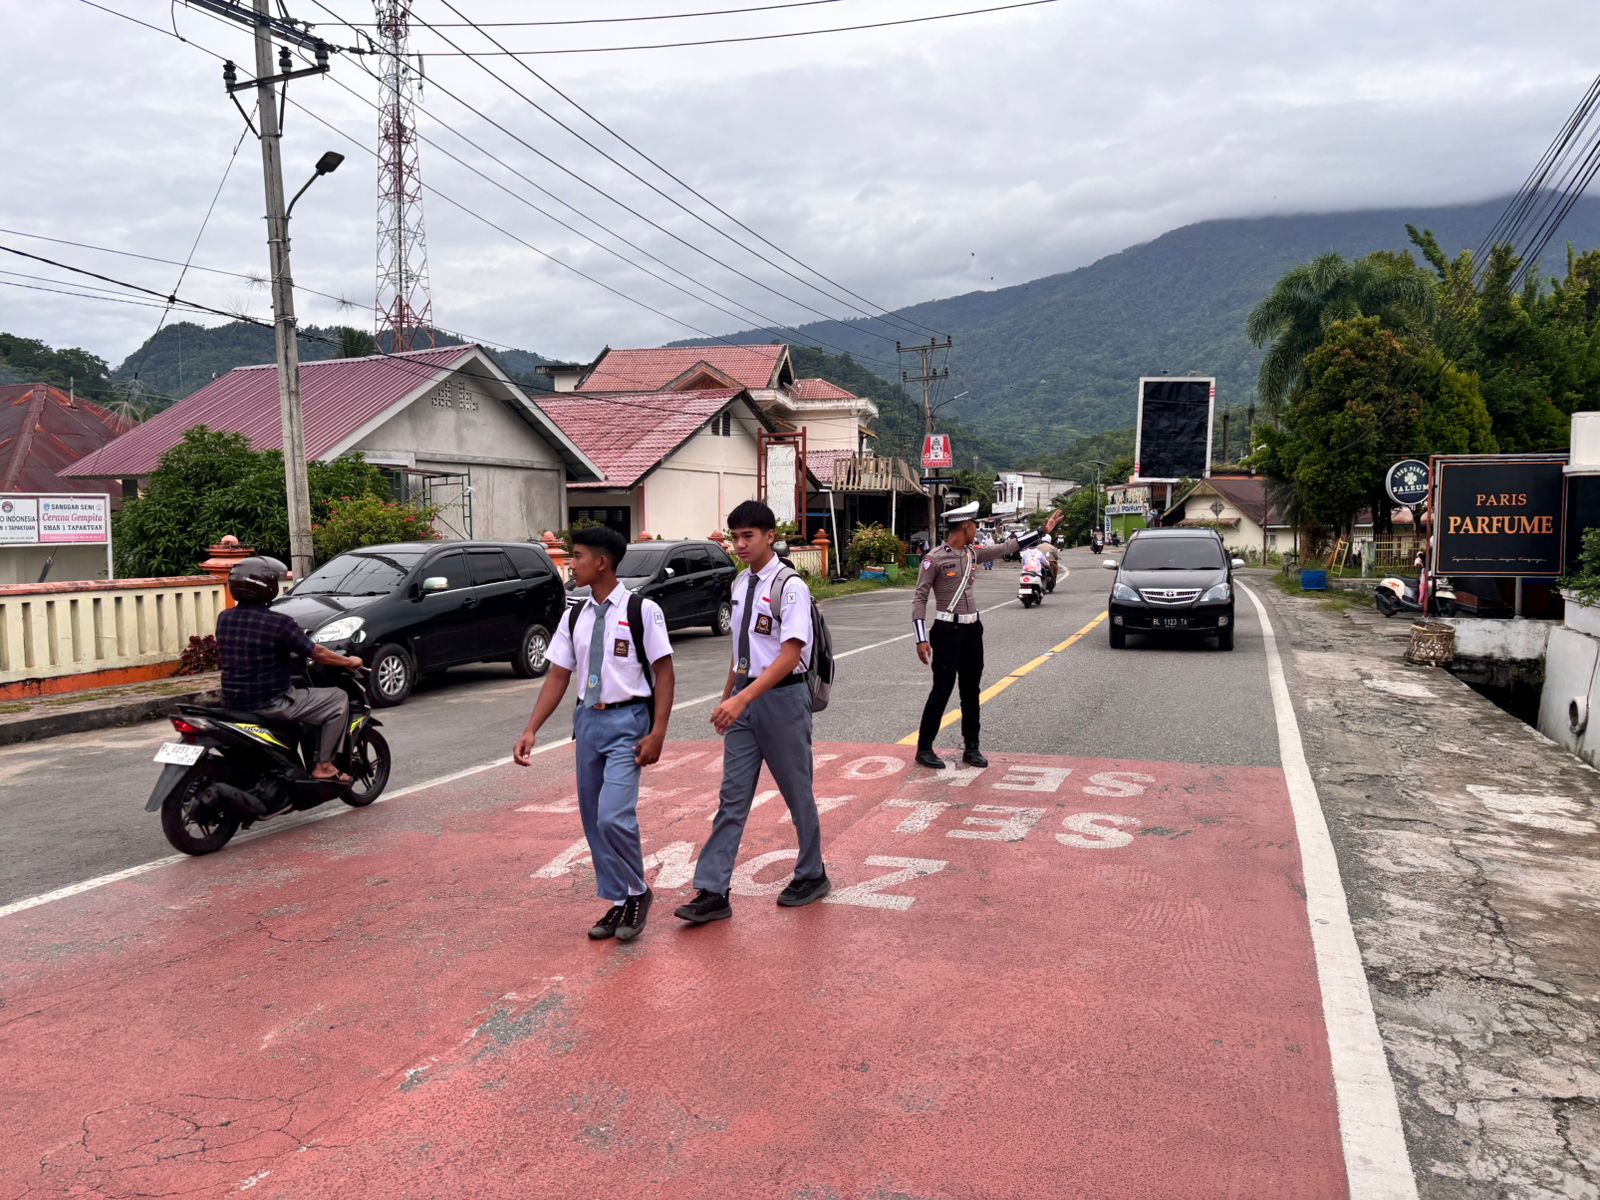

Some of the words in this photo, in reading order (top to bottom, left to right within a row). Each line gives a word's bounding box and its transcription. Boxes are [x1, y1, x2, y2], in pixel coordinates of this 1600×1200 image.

[1392, 484, 1429, 493] SALEUM
[1475, 493, 1528, 506] PARIS
[5, 515, 36, 523] INDONESIA
[42, 512, 70, 522] Cerana
[71, 512, 103, 523] Gempita
[1448, 515, 1553, 535] PARFUME
